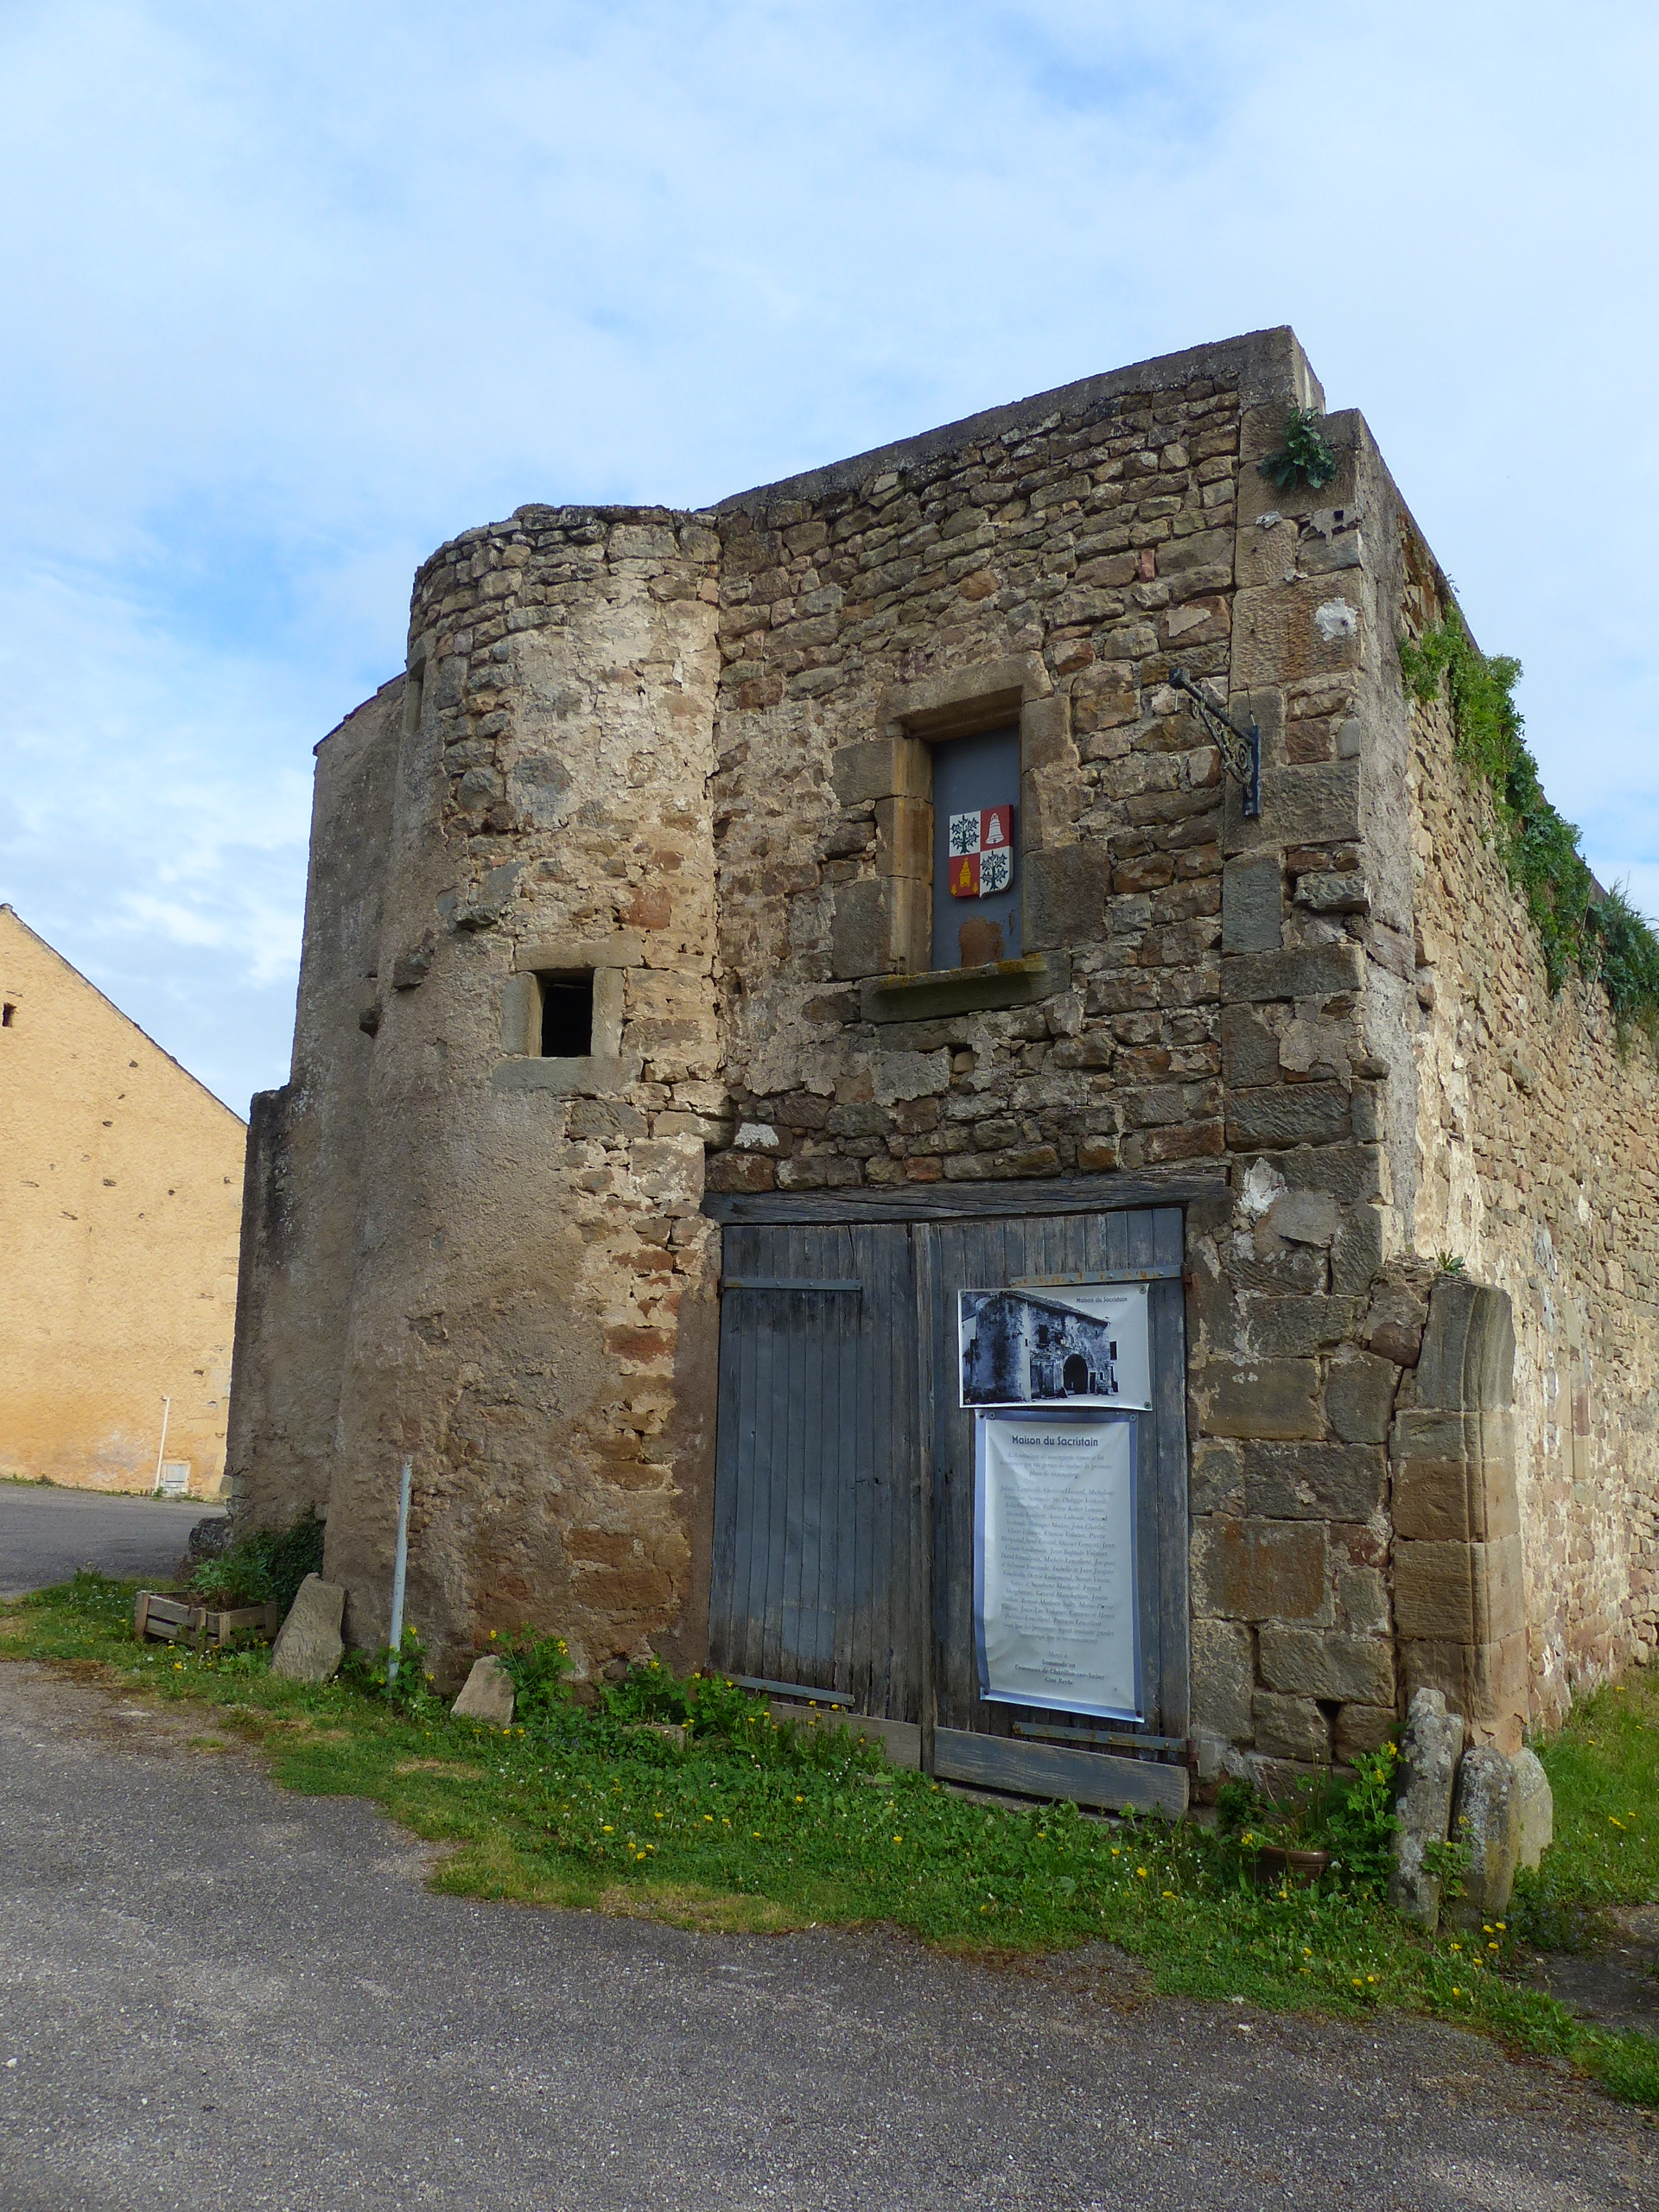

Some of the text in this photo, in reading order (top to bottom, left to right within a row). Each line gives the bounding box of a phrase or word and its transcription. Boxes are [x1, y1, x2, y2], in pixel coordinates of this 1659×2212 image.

[1012, 1435, 1098, 1446] Maison du Sacristain
